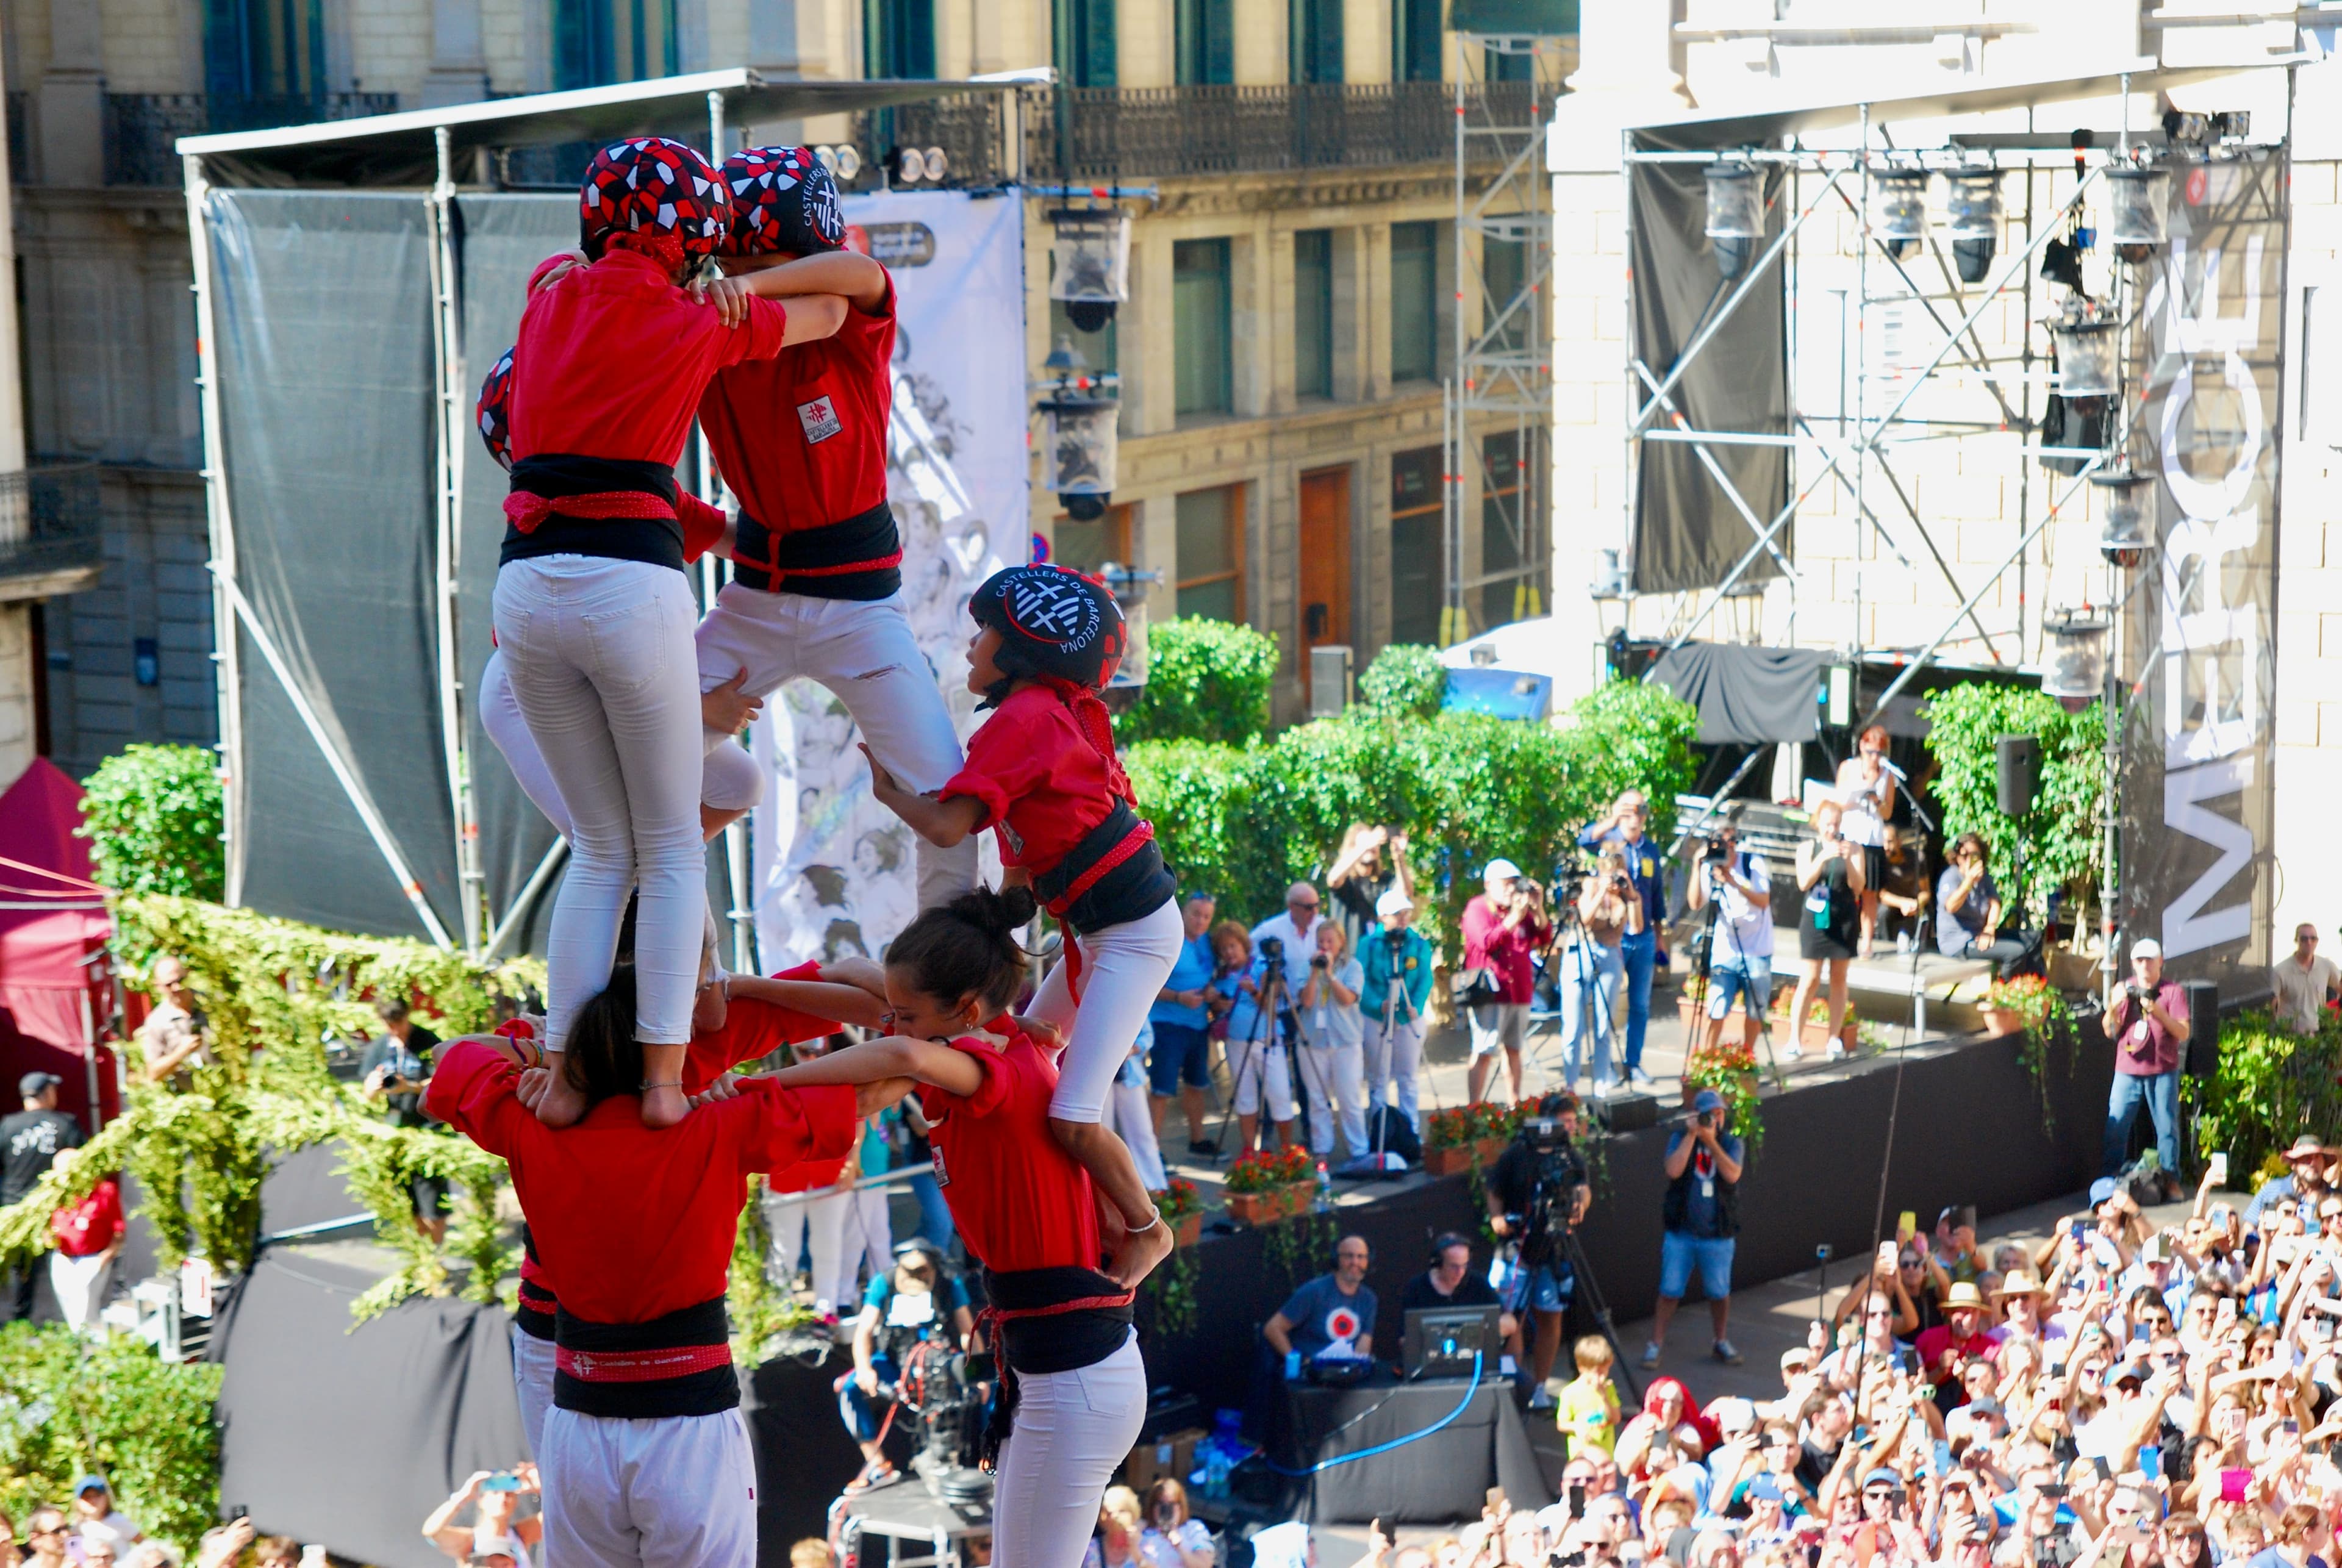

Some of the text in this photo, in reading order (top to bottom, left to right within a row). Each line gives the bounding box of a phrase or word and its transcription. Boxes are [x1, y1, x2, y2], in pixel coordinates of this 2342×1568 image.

[803, 168, 822, 226] CASTELLERS
[995, 570, 1100, 654] CASTELLERS DE BARCELONA
